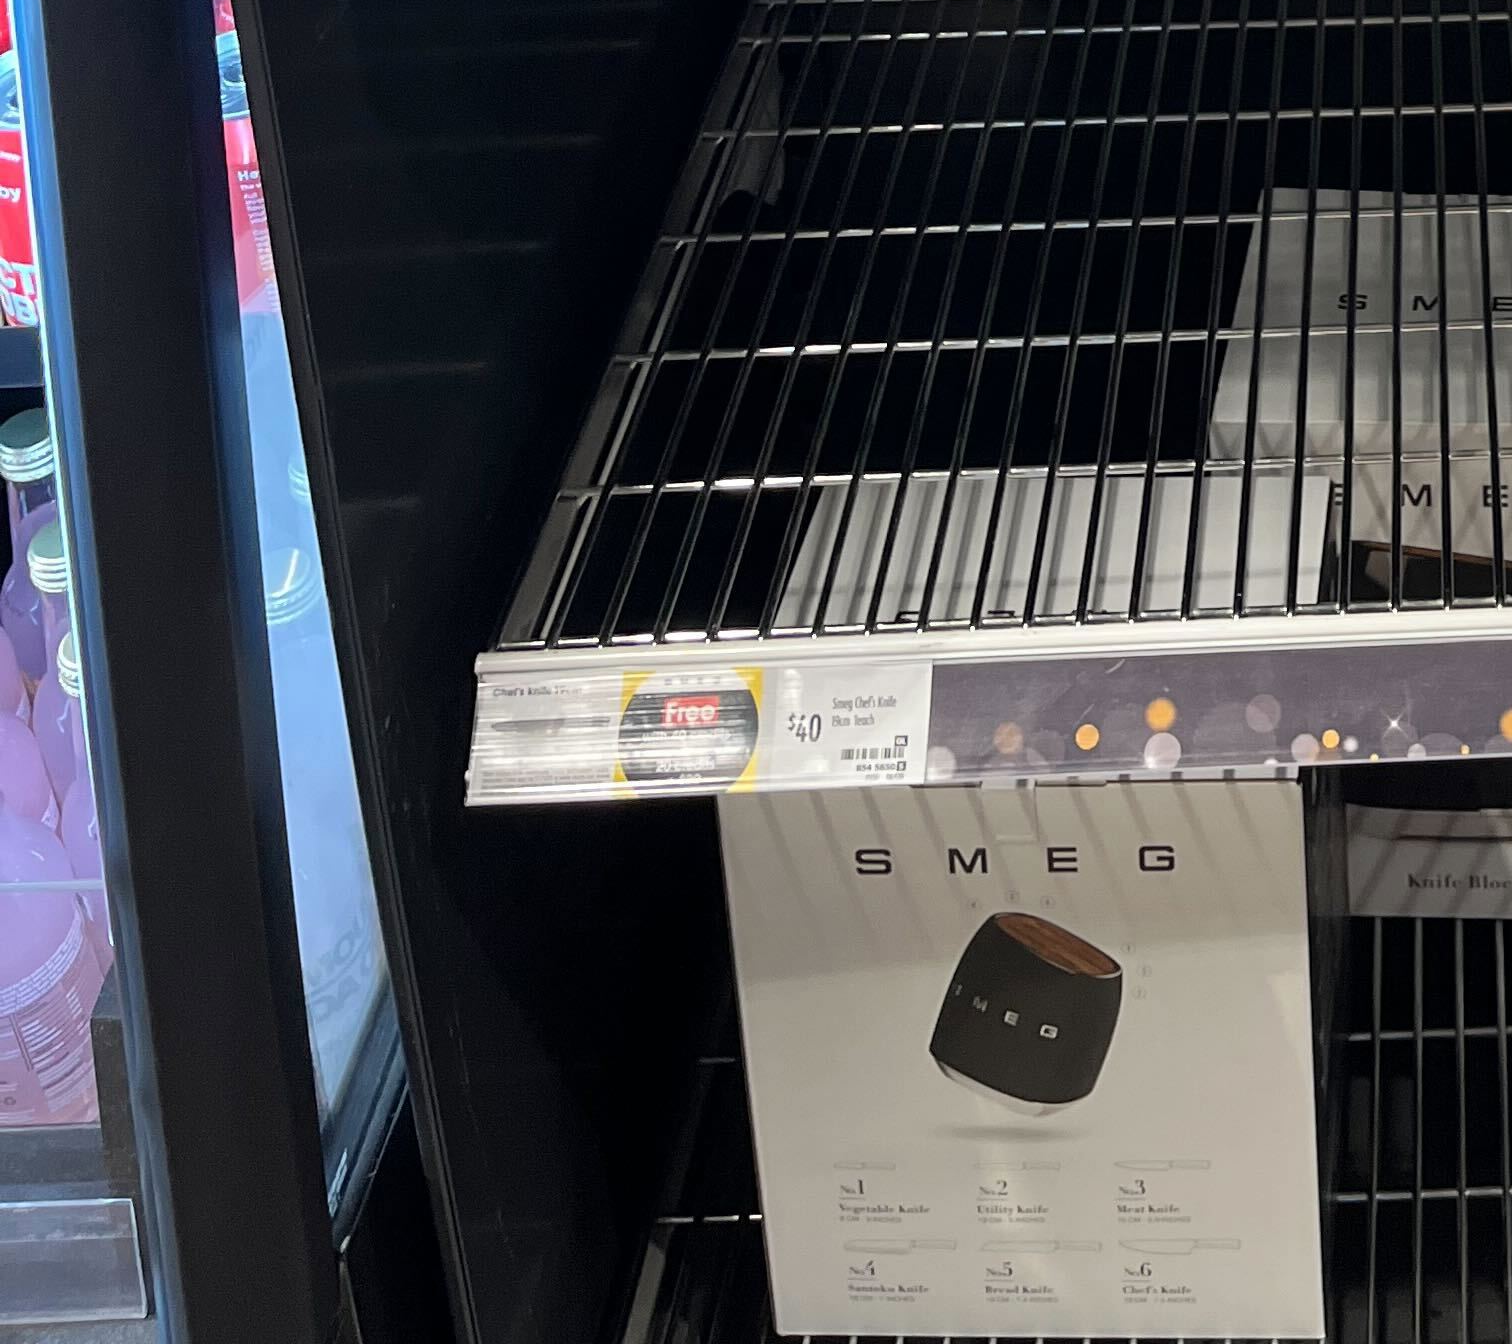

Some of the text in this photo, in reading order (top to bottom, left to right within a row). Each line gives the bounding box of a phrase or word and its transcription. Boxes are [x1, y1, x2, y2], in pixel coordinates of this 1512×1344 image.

[664, 700, 715, 723] Free
[788, 713, 822, 743] $40
[855, 845, 1176, 876] SMEG
[1407, 873, 1462, 889] Knife
